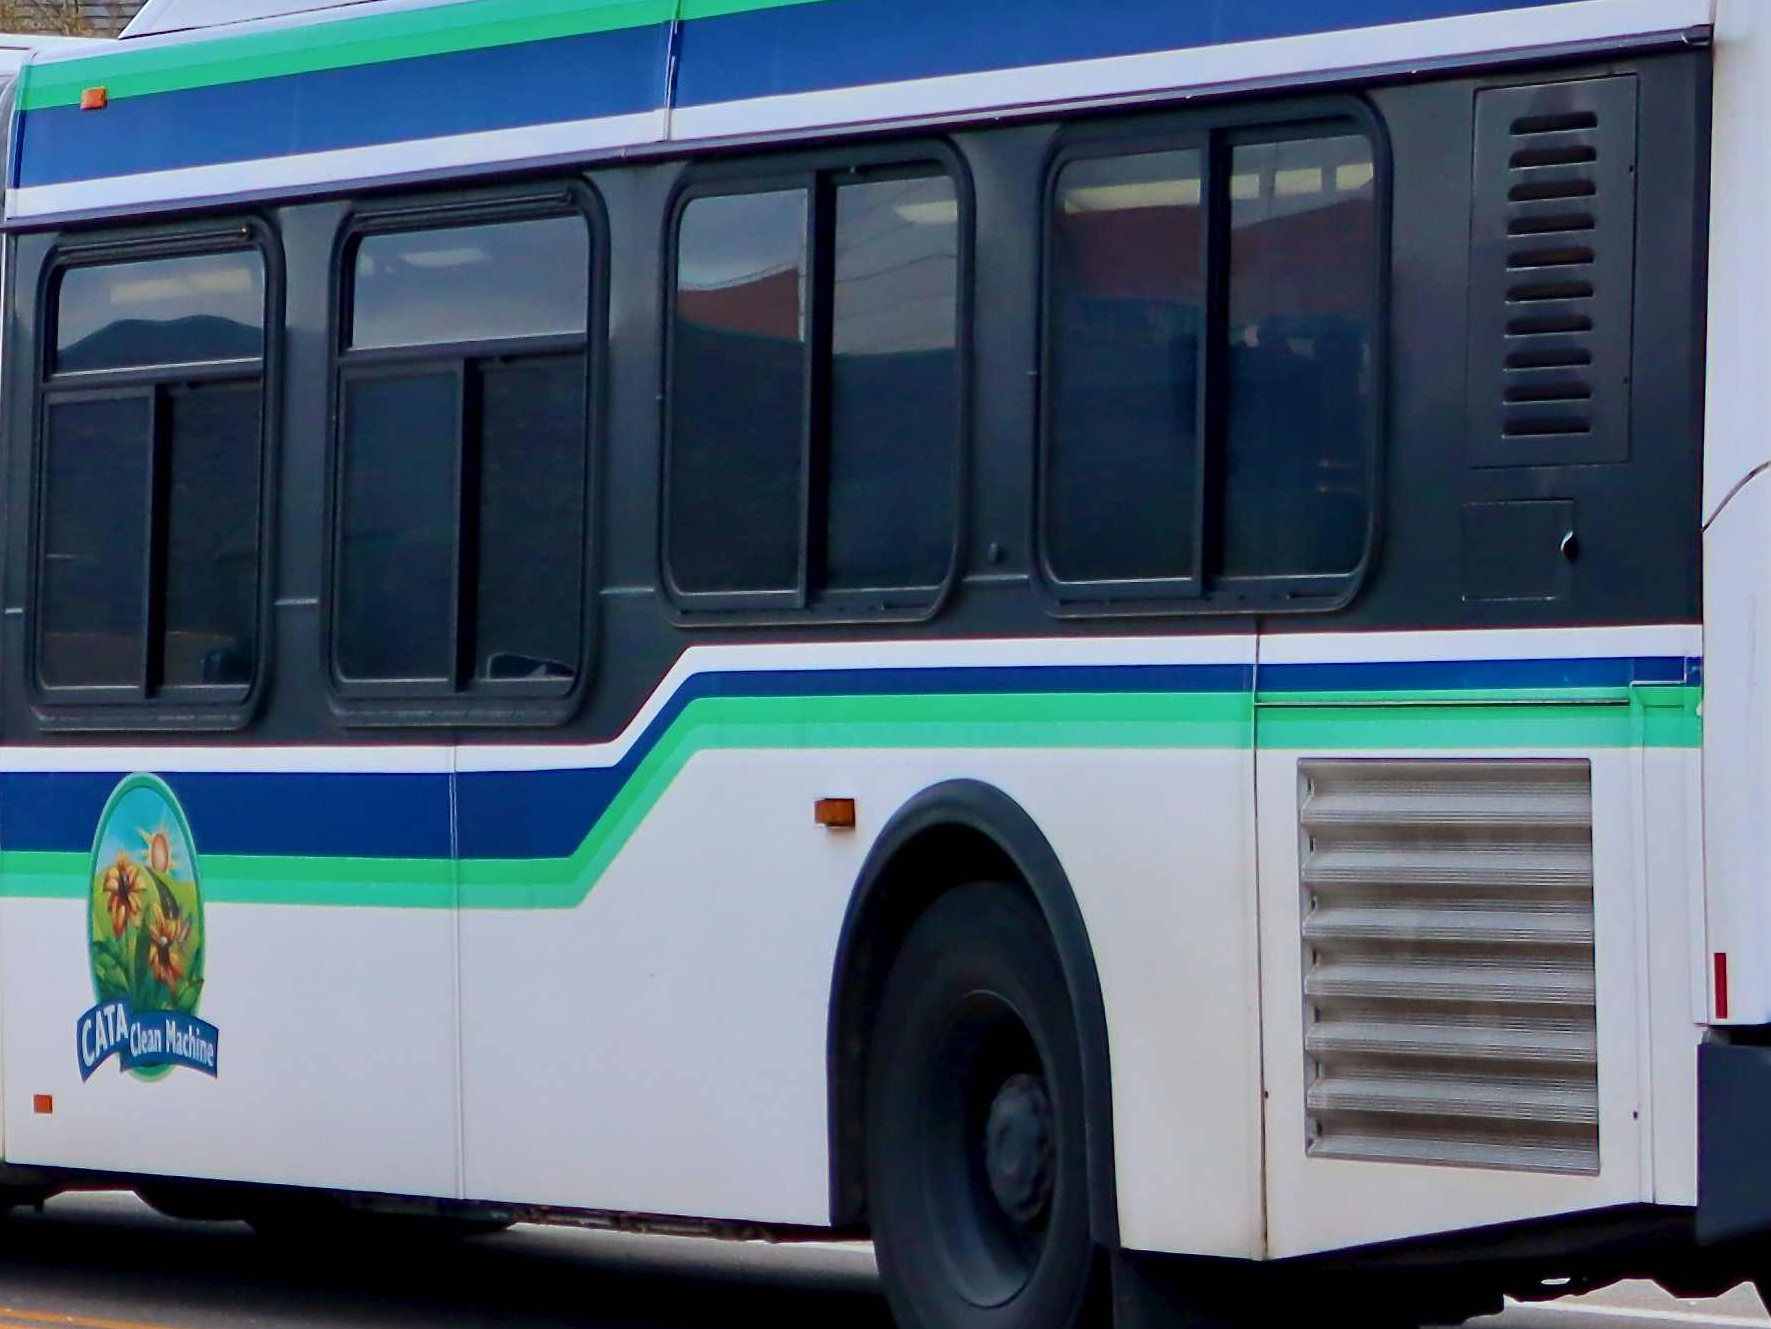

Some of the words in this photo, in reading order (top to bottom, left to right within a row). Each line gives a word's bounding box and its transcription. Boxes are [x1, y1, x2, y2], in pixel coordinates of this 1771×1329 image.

[81, 1003, 129, 1067] CATA
[130, 1021, 162, 1058] Clean
[165, 1019, 214, 1067] Machine
